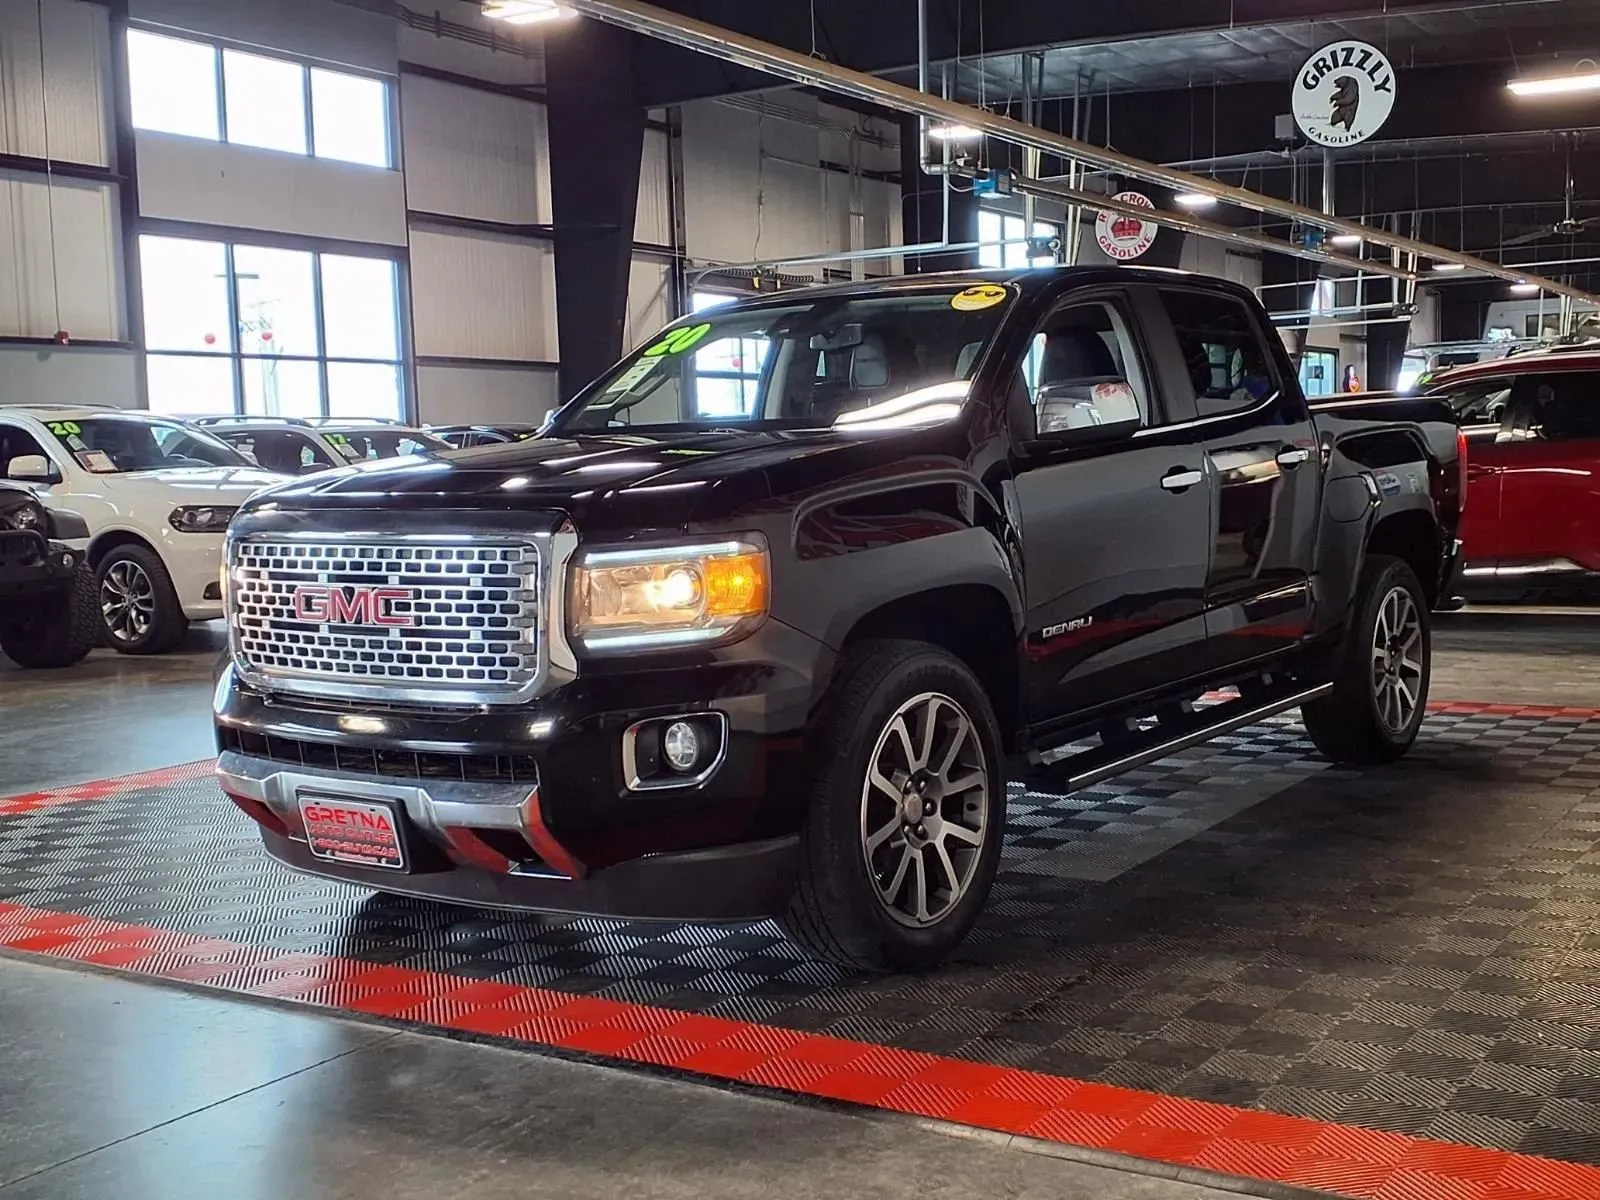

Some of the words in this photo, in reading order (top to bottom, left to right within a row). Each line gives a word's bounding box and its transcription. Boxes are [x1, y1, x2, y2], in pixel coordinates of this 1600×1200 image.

[1302, 46, 1392, 91] GRIZZLY
[1308, 126, 1366, 144] GASOLINE
[1099, 233, 1153, 258] GASOLINE
[643, 323, 712, 357] 20
[47, 421, 81, 435] 20
[294, 585, 414, 627] GMC
[1042, 615, 1093, 638] DENALI
[304, 806, 391, 830] GRETNA
